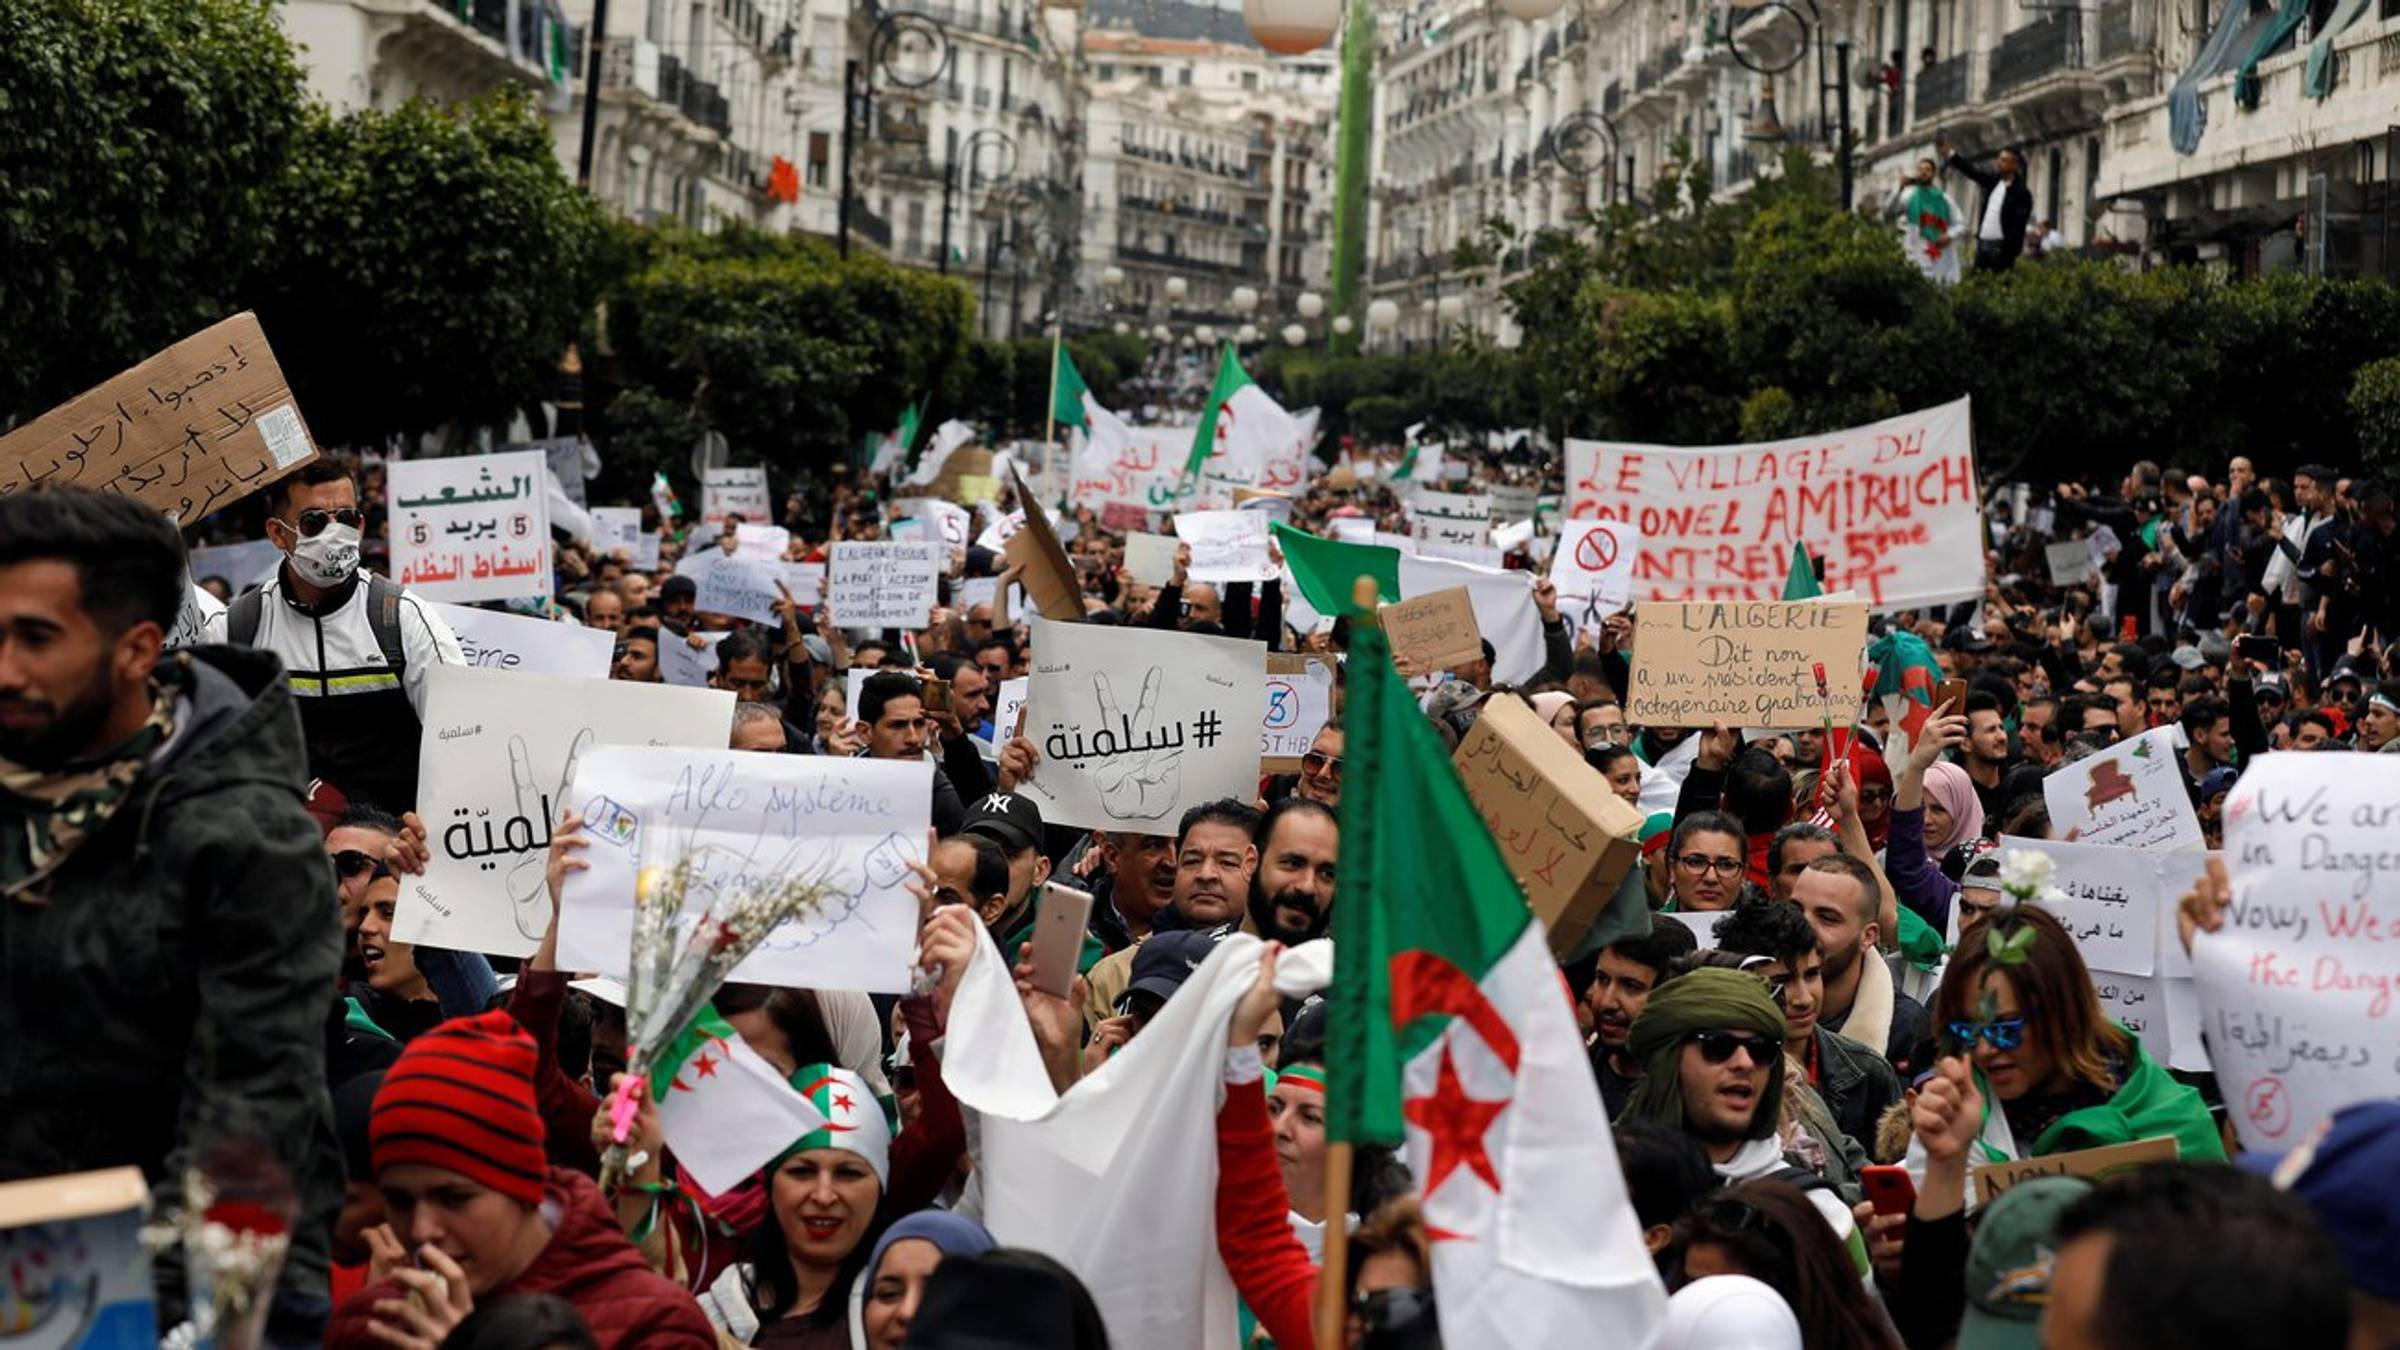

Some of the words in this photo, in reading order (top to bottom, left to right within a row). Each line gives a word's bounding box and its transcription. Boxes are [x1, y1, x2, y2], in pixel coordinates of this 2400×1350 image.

[1577, 454, 1643, 494] LE
[1664, 443, 1844, 490] VILLAGE
[1872, 429, 1925, 464] DU
[397, 466, 531, 518] الشعب
[445, 517, 497, 541] يريد
[400, 552, 464, 587] النظام
[1698, 634, 1752, 668] Dit
[1765, 647, 1811, 664] non
[1664, 671, 1696, 686] un
[2256, 785, 2330, 827] We
[2240, 840, 2274, 865] in
[2318, 900, 2384, 942] We
[2248, 952, 2300, 988] the
